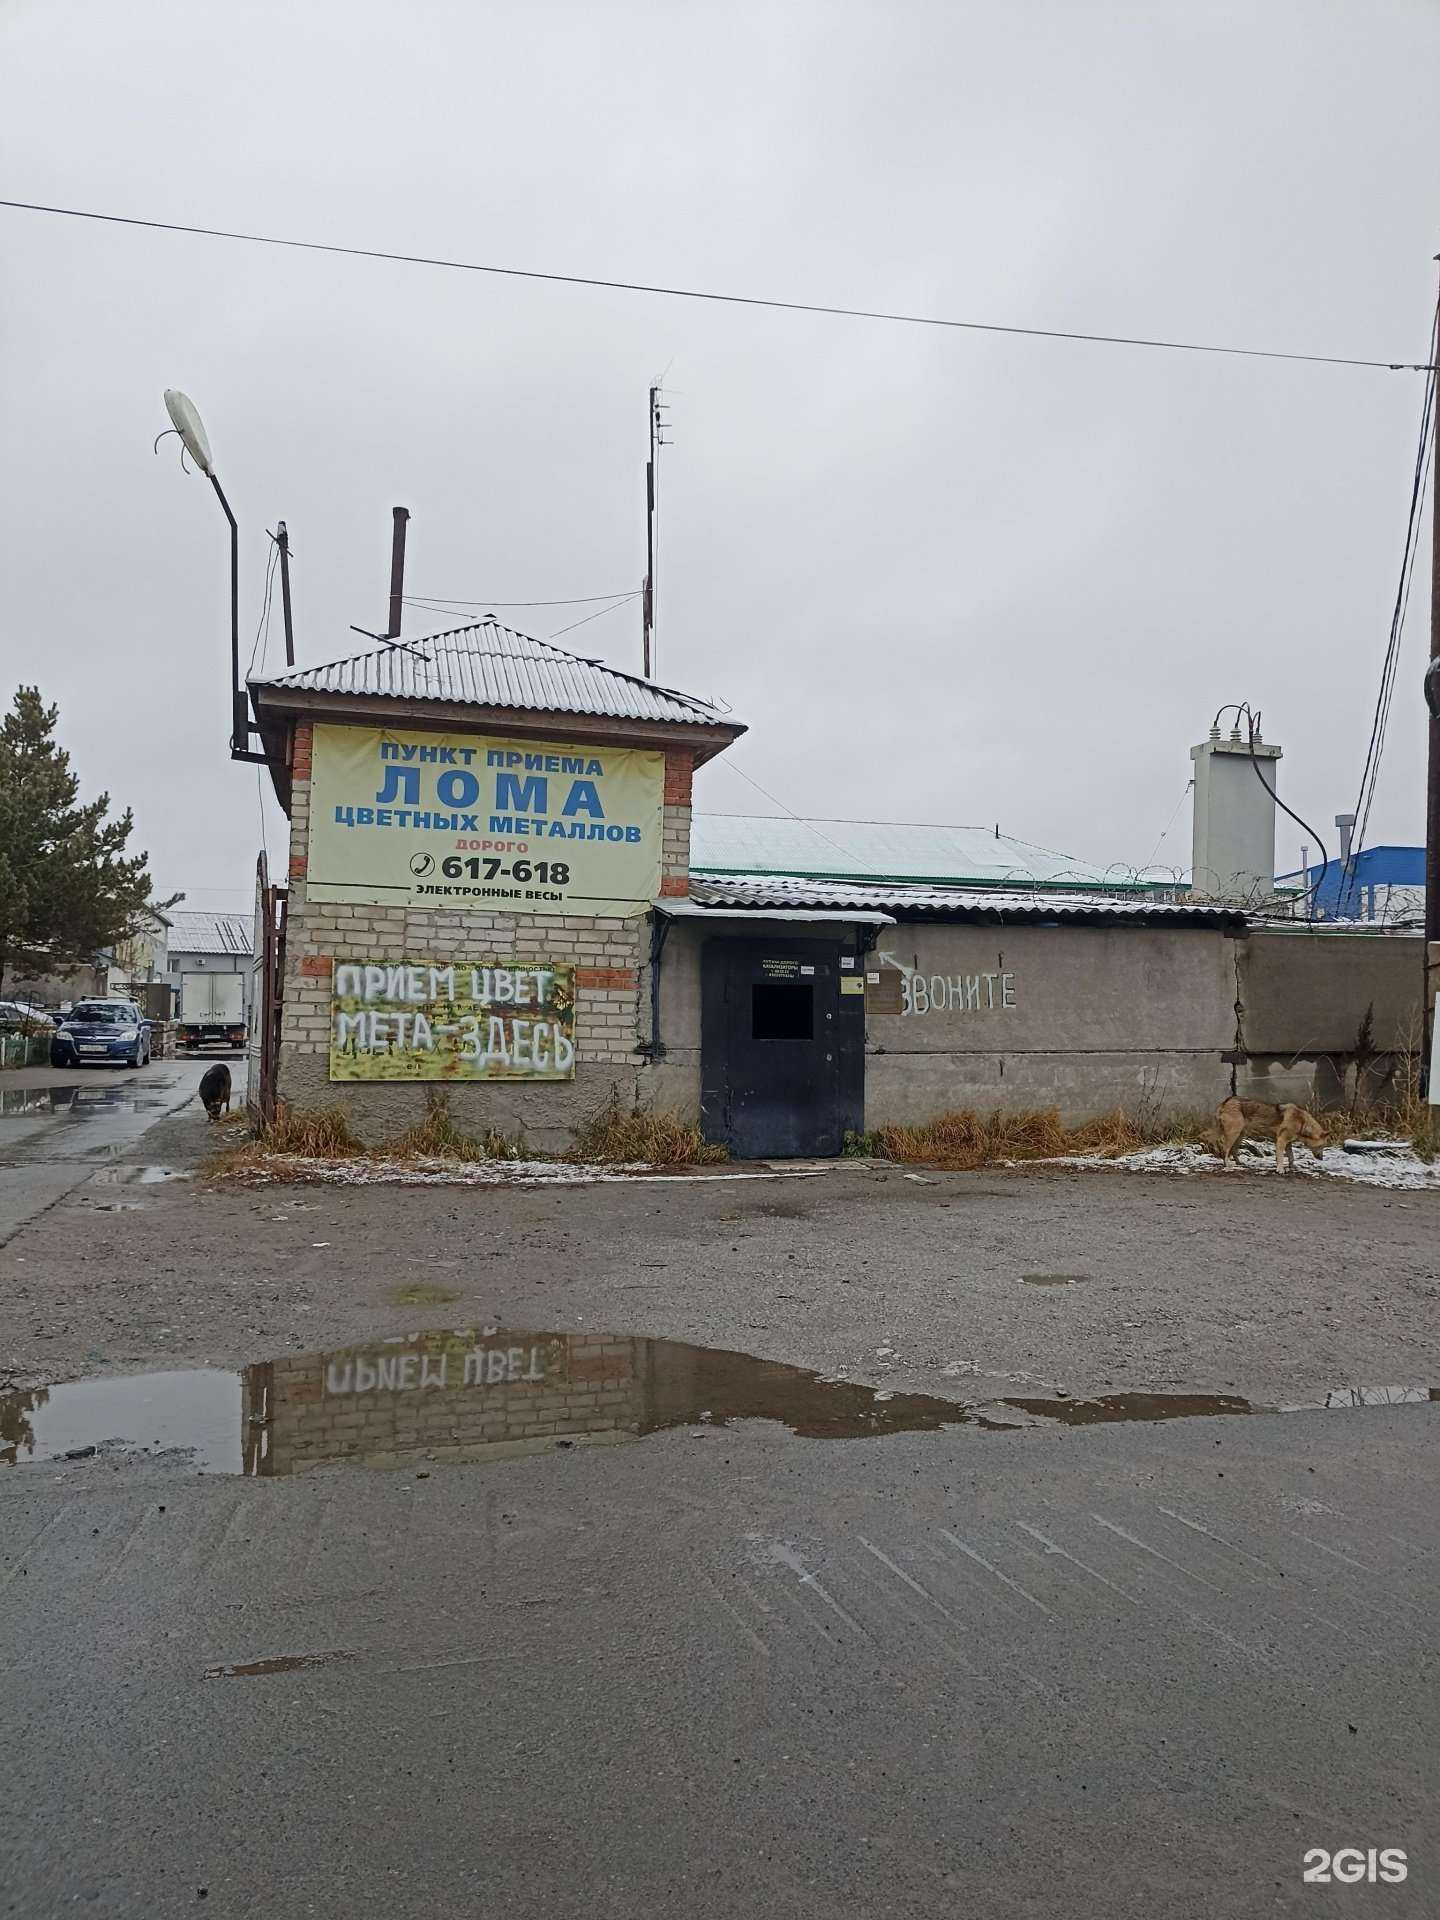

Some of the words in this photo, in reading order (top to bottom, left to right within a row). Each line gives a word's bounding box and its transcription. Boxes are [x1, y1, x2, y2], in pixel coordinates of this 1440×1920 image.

[380, 742, 477, 765] ПУНКТ
[487, 749, 604, 776] ПРИЕМА
[375, 765, 605, 819] ЛОМА
[335, 805, 480, 832] ЦВЕТНЫХ
[489, 815, 642, 843] МЕТАЛЛОВ
[455, 838, 529, 854] ДОРОГО
[441, 856, 570, 885] 617-618
[416, 884, 522, 899] ЭЛЕКТРОННЫЕ
[525, 889, 563, 901] ВЕСЫ
[336, 964, 454, 1001] ПРИЕМ
[471, 967, 554, 1005] ЦВЕТ
[901, 973, 1017, 1016] ЗВОНИТЕ
[458, 1015, 574, 1072] ЗДЕСЬ
